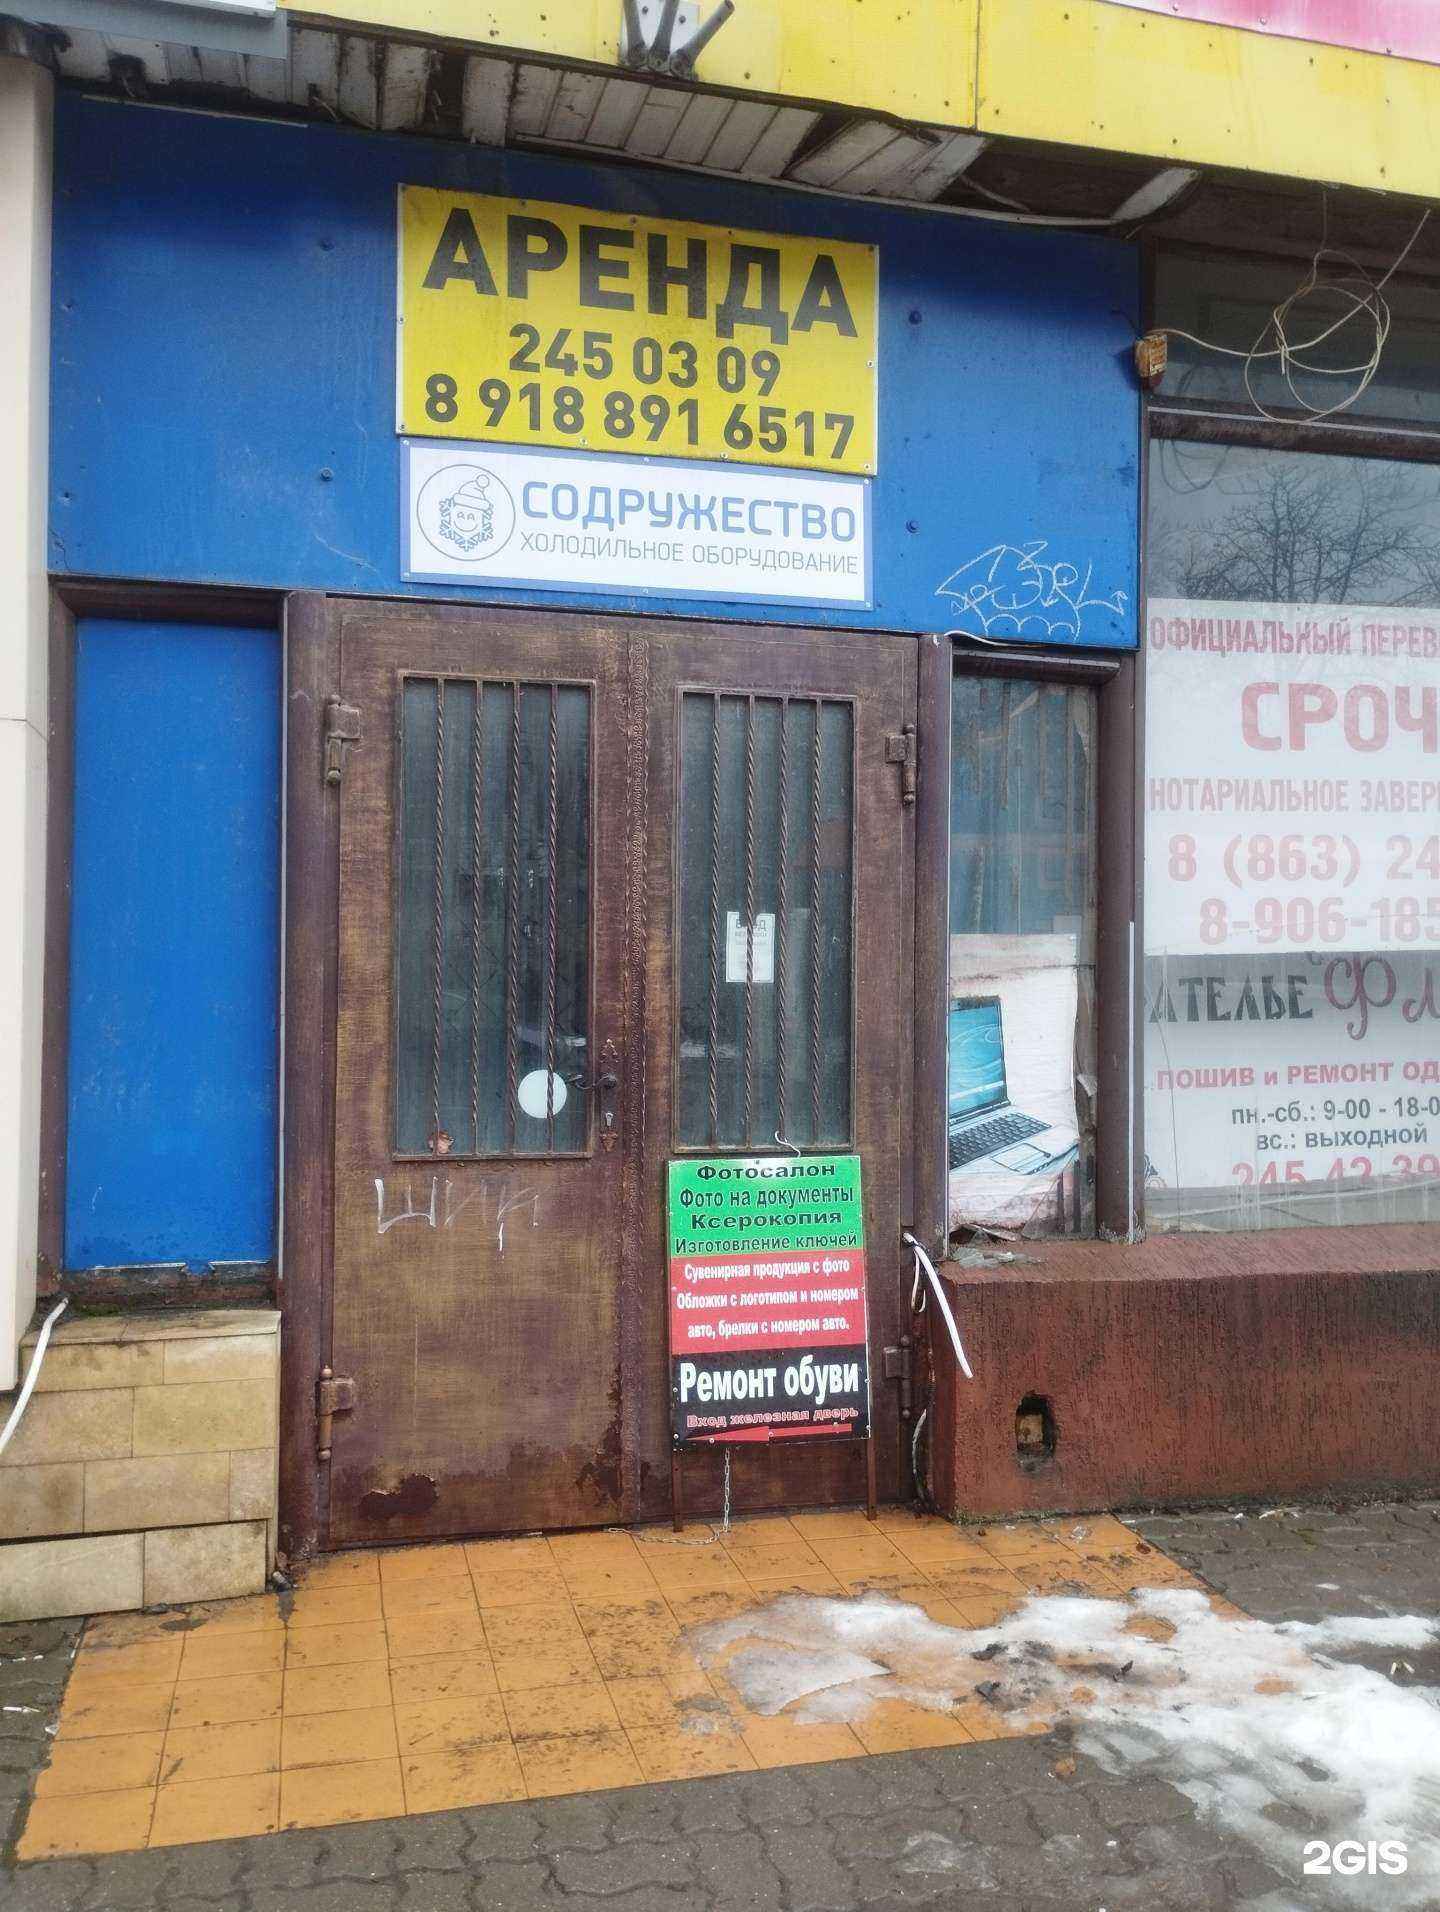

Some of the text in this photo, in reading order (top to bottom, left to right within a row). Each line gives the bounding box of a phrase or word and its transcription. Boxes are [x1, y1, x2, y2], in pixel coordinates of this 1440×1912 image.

[422, 207, 858, 345] АРЕНДА
[509, 323, 781, 397] 245 03 09
[425, 373, 855, 459] 8 918 891 6517
[522, 480, 856, 542] СОДРУЖЕСТВО
[520, 532, 858, 575] ХОЛОДИЛЬНОЕ ОБОРУДОВАНИЕ
[1150, 616, 1351, 657] ОФИЦИАЛЬНЫЙ
[1240, 681, 1438, 753] СРОЧ
[1150, 777, 1350, 813] НОТАРИАЛЬНОЕ
[1168, 833, 1197, 882] 8
[1223, 834, 1361, 889] (863)
[1149, 973, 1313, 1023] АТЕЛЬЕ
[1156, 1067, 1255, 1090] ПОШИВ
[1287, 1061, 1394, 1085] РЕМОНТ
[1323, 1098, 1371, 1121] 9-00
[696, 1163, 836, 1181] Фотосалон
[679, 1185, 854, 1209] Фото на документы
[691, 1211, 842, 1231] Ксерокопия
[675, 1230, 858, 1254] Изготовление ключей
[684, 1258, 850, 1283] Сувенирная продукция с фото
[676, 1287, 859, 1310] Обложки с логотипом и номером
[687, 1317, 851, 1340] авто, брелки с номером авто.
[679, 1354, 859, 1405] Ремонт обуви
[686, 1406, 859, 1429] Вход железная дверь
